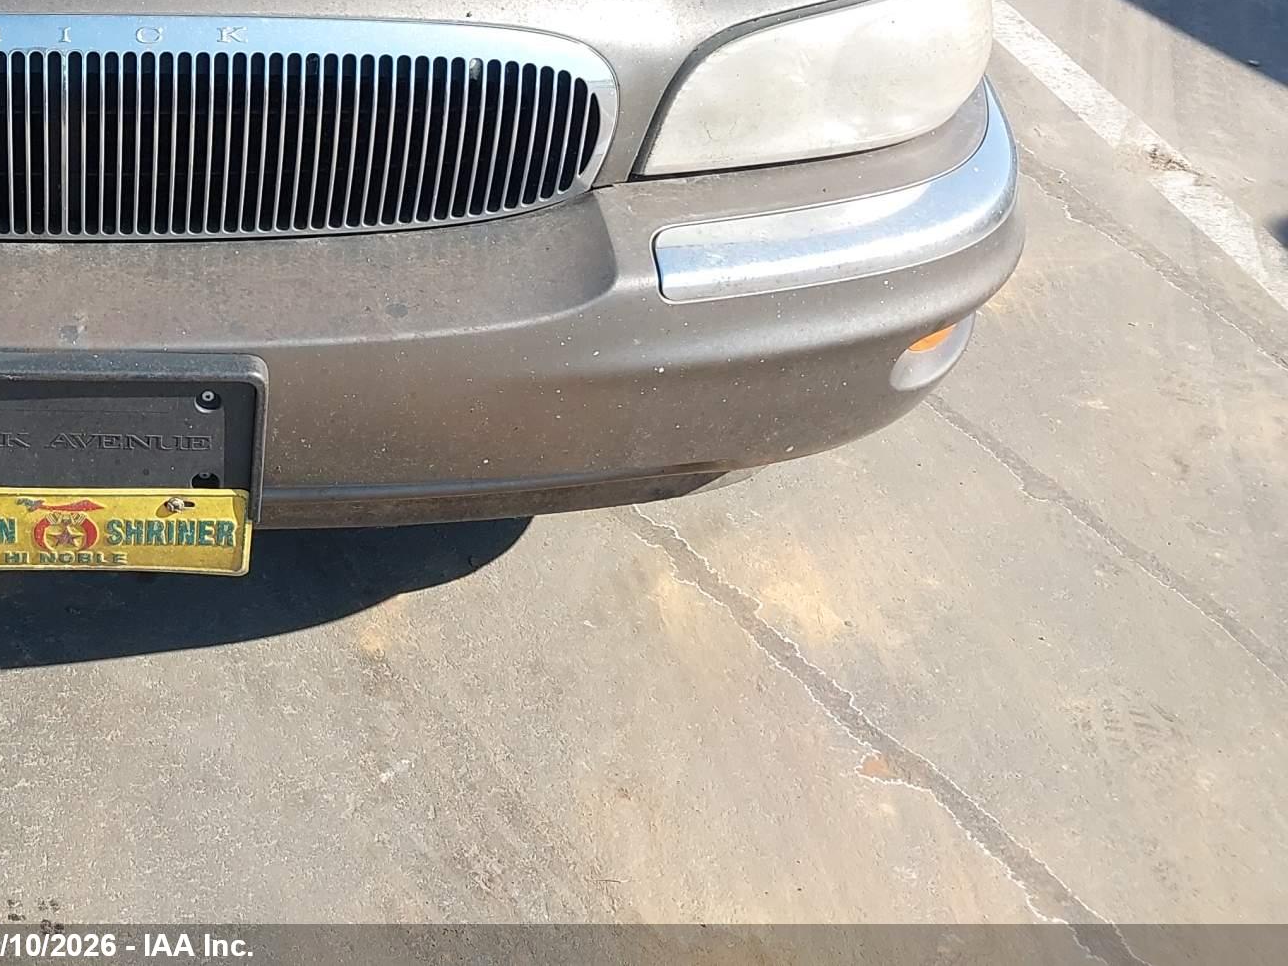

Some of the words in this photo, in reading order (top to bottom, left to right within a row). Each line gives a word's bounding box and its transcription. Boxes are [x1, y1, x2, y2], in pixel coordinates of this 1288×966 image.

[44, 431, 213, 452] AVENUE
[105, 517, 237, 547] SHRINER
[3, 551, 30, 564] HI
[39, 551, 128, 565] NOBLE
